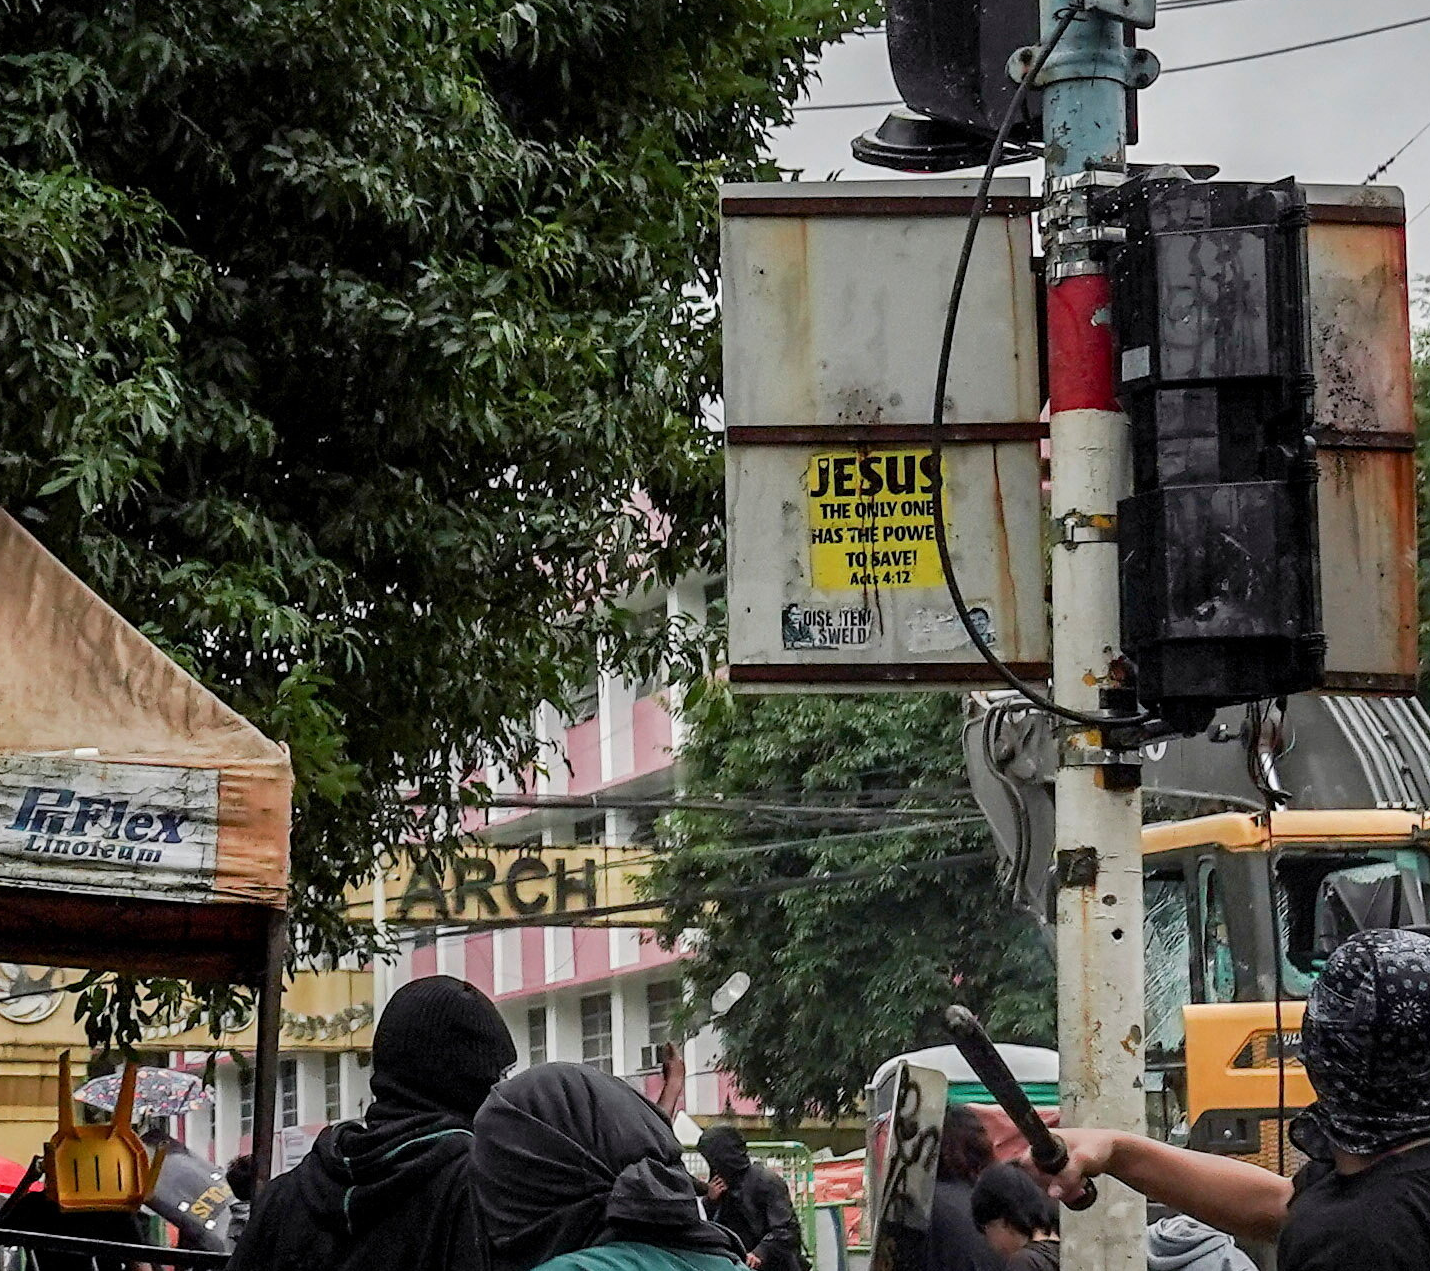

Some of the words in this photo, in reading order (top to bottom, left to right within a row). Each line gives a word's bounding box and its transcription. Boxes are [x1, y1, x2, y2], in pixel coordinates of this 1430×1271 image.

[810, 456, 943, 497] JESUS
[820, 503, 851, 519] THE
[855, 502, 897, 518] ONLY
[901, 500, 935, 517] ONE
[812, 528, 844, 544] HAS
[848, 527, 879, 543] THE
[884, 525, 936, 542] POWE
[845, 551, 868, 568] TO
[872, 550, 917, 567] SAVE!
[850, 573, 878, 585] Acts
[882, 571, 910, 584] 4:12
